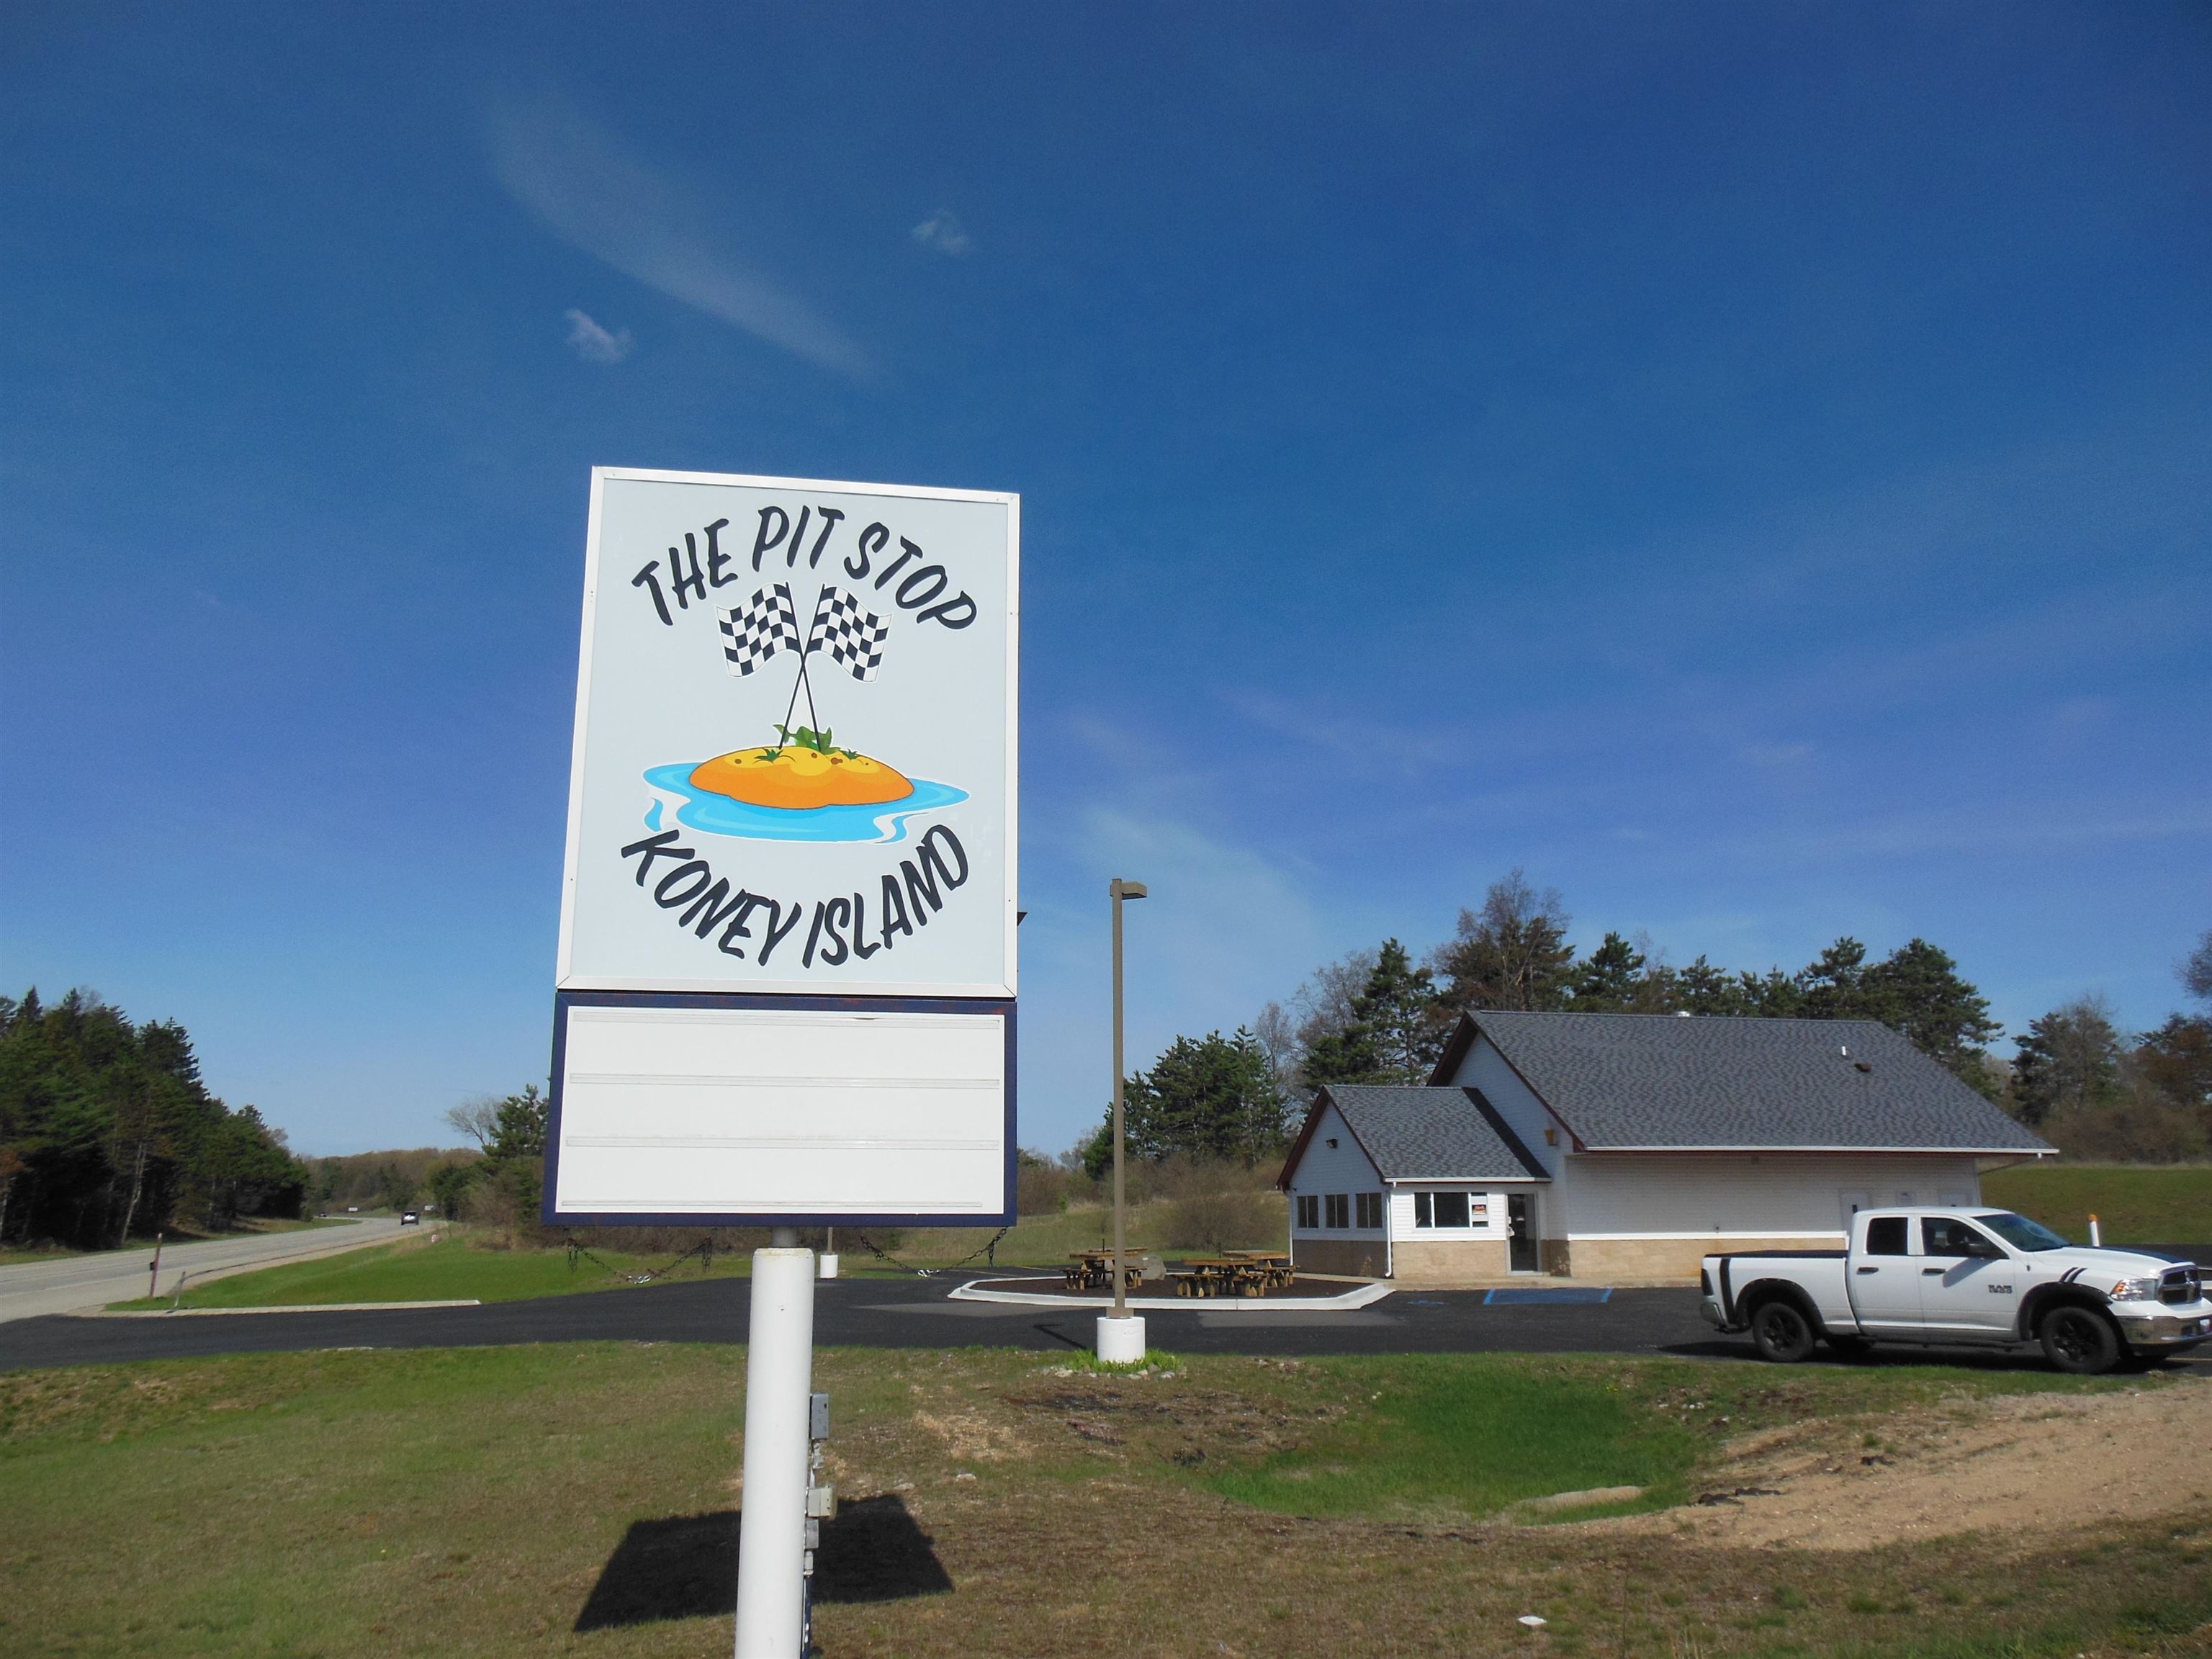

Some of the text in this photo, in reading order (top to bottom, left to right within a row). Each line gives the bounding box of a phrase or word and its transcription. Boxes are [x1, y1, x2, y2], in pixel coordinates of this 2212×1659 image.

[631, 505, 977, 630] THE PIT STOP
[621, 824, 968, 969] KONEY ISLAND
